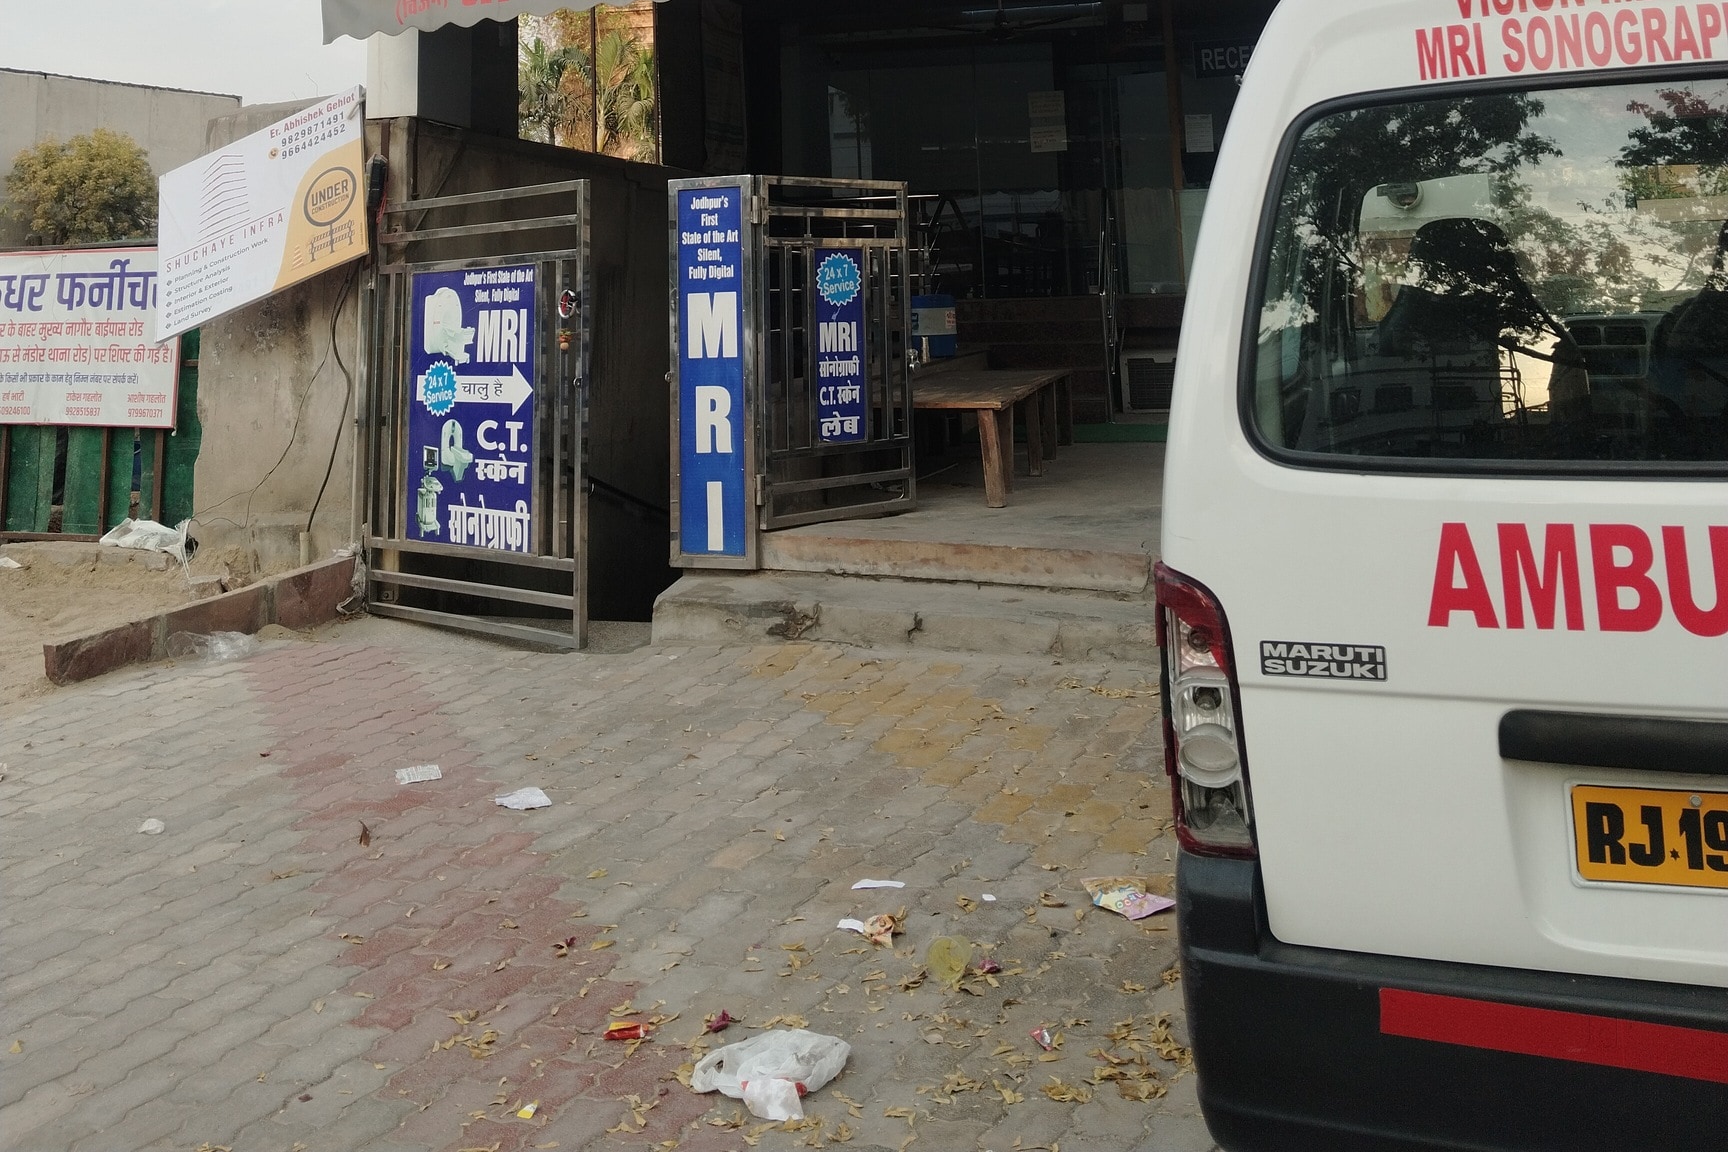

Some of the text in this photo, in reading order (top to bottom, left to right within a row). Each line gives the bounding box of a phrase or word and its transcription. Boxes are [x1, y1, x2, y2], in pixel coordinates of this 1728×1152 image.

[1415, 1, 1728, 81] MRI SONOGRAP
[1201, 45, 1255, 70] RECE
[284, 108, 324, 133] Abhishek
[326, 92, 355, 113] Gehlot
[281, 111, 344, 147] 9829871491
[282, 123, 346, 160] 9664424452
[311, 178, 349, 207] UNDER
[311, 193, 350, 215] CONSTRUCTION
[691, 195, 729, 210] Jodhpur's
[701, 213, 718, 226] First
[166, 212, 283, 273] SHUCHAYE INFRA
[682, 229, 738, 245] State of the Art
[174, 267, 202, 283] Planning
[209, 247, 250, 268] Construction
[251, 237, 269, 249] Work
[697, 248, 722, 262] Silent,
[56, 258, 158, 311] फर्नीच
[174, 265, 231, 294] Structure Analysis
[688, 264, 734, 280] Fully Digital
[174, 290, 197, 305] Interior
[204, 277, 229, 291] Exterior
[174, 285, 233, 315] Estimation Costing
[823, 280, 855, 296] Service
[7, 317, 144, 341] के बाहर मुख्य नागौर बाईपास रोड
[173, 306, 212, 326] Land Survey
[476, 308, 528, 363] MRI
[819, 321, 857, 353] MRI
[12, 344, 21, 363] से
[22, 344, 46, 363] मंडोर
[48, 348, 71, 363] थाना
[94, 348, 107, 363] पर
[108, 343, 132, 363] शिफ्ट
[133, 343, 146, 363] की
[819, 355, 859, 378] सोनोग्राफी
[426, 388, 453, 404] Service
[461, 378, 503, 400] चालु है
[476, 419, 528, 453] C.T.
[820, 411, 860, 437] लेब
[475, 453, 528, 484] स्केन
[448, 492, 531, 553] सोनोग्राफी
[1427, 522, 1728, 638] AMBU
[1262, 643, 1383, 663] MARUTI
[1264, 659, 1385, 680] SUZUKI
